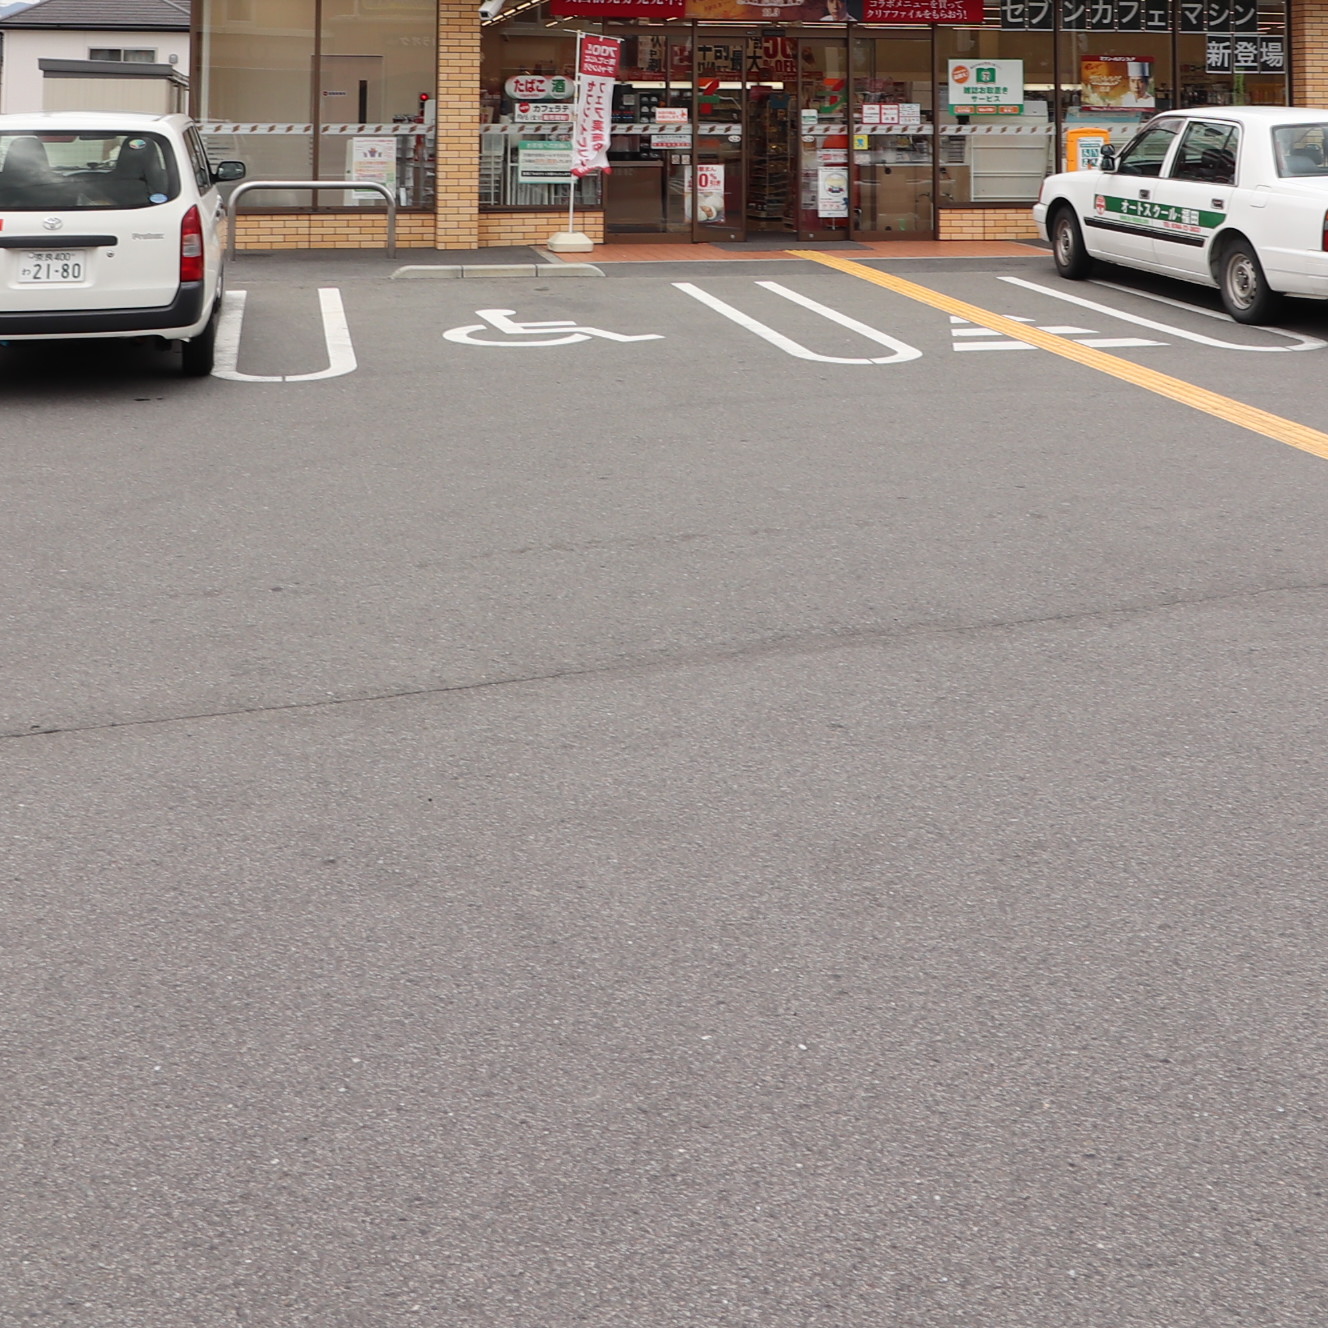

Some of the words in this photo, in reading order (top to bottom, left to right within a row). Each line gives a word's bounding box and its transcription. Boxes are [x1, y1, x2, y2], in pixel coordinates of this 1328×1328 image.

[869, 0, 965, 9] コラボメニューを買って
[1206, 41, 1284, 68] 新登場
[514, 79, 546, 93] たばこ
[552, 79, 566, 93] 酒
[533, 105, 569, 113] カフェラテ
[32, 263, 81, 280] 21-80
